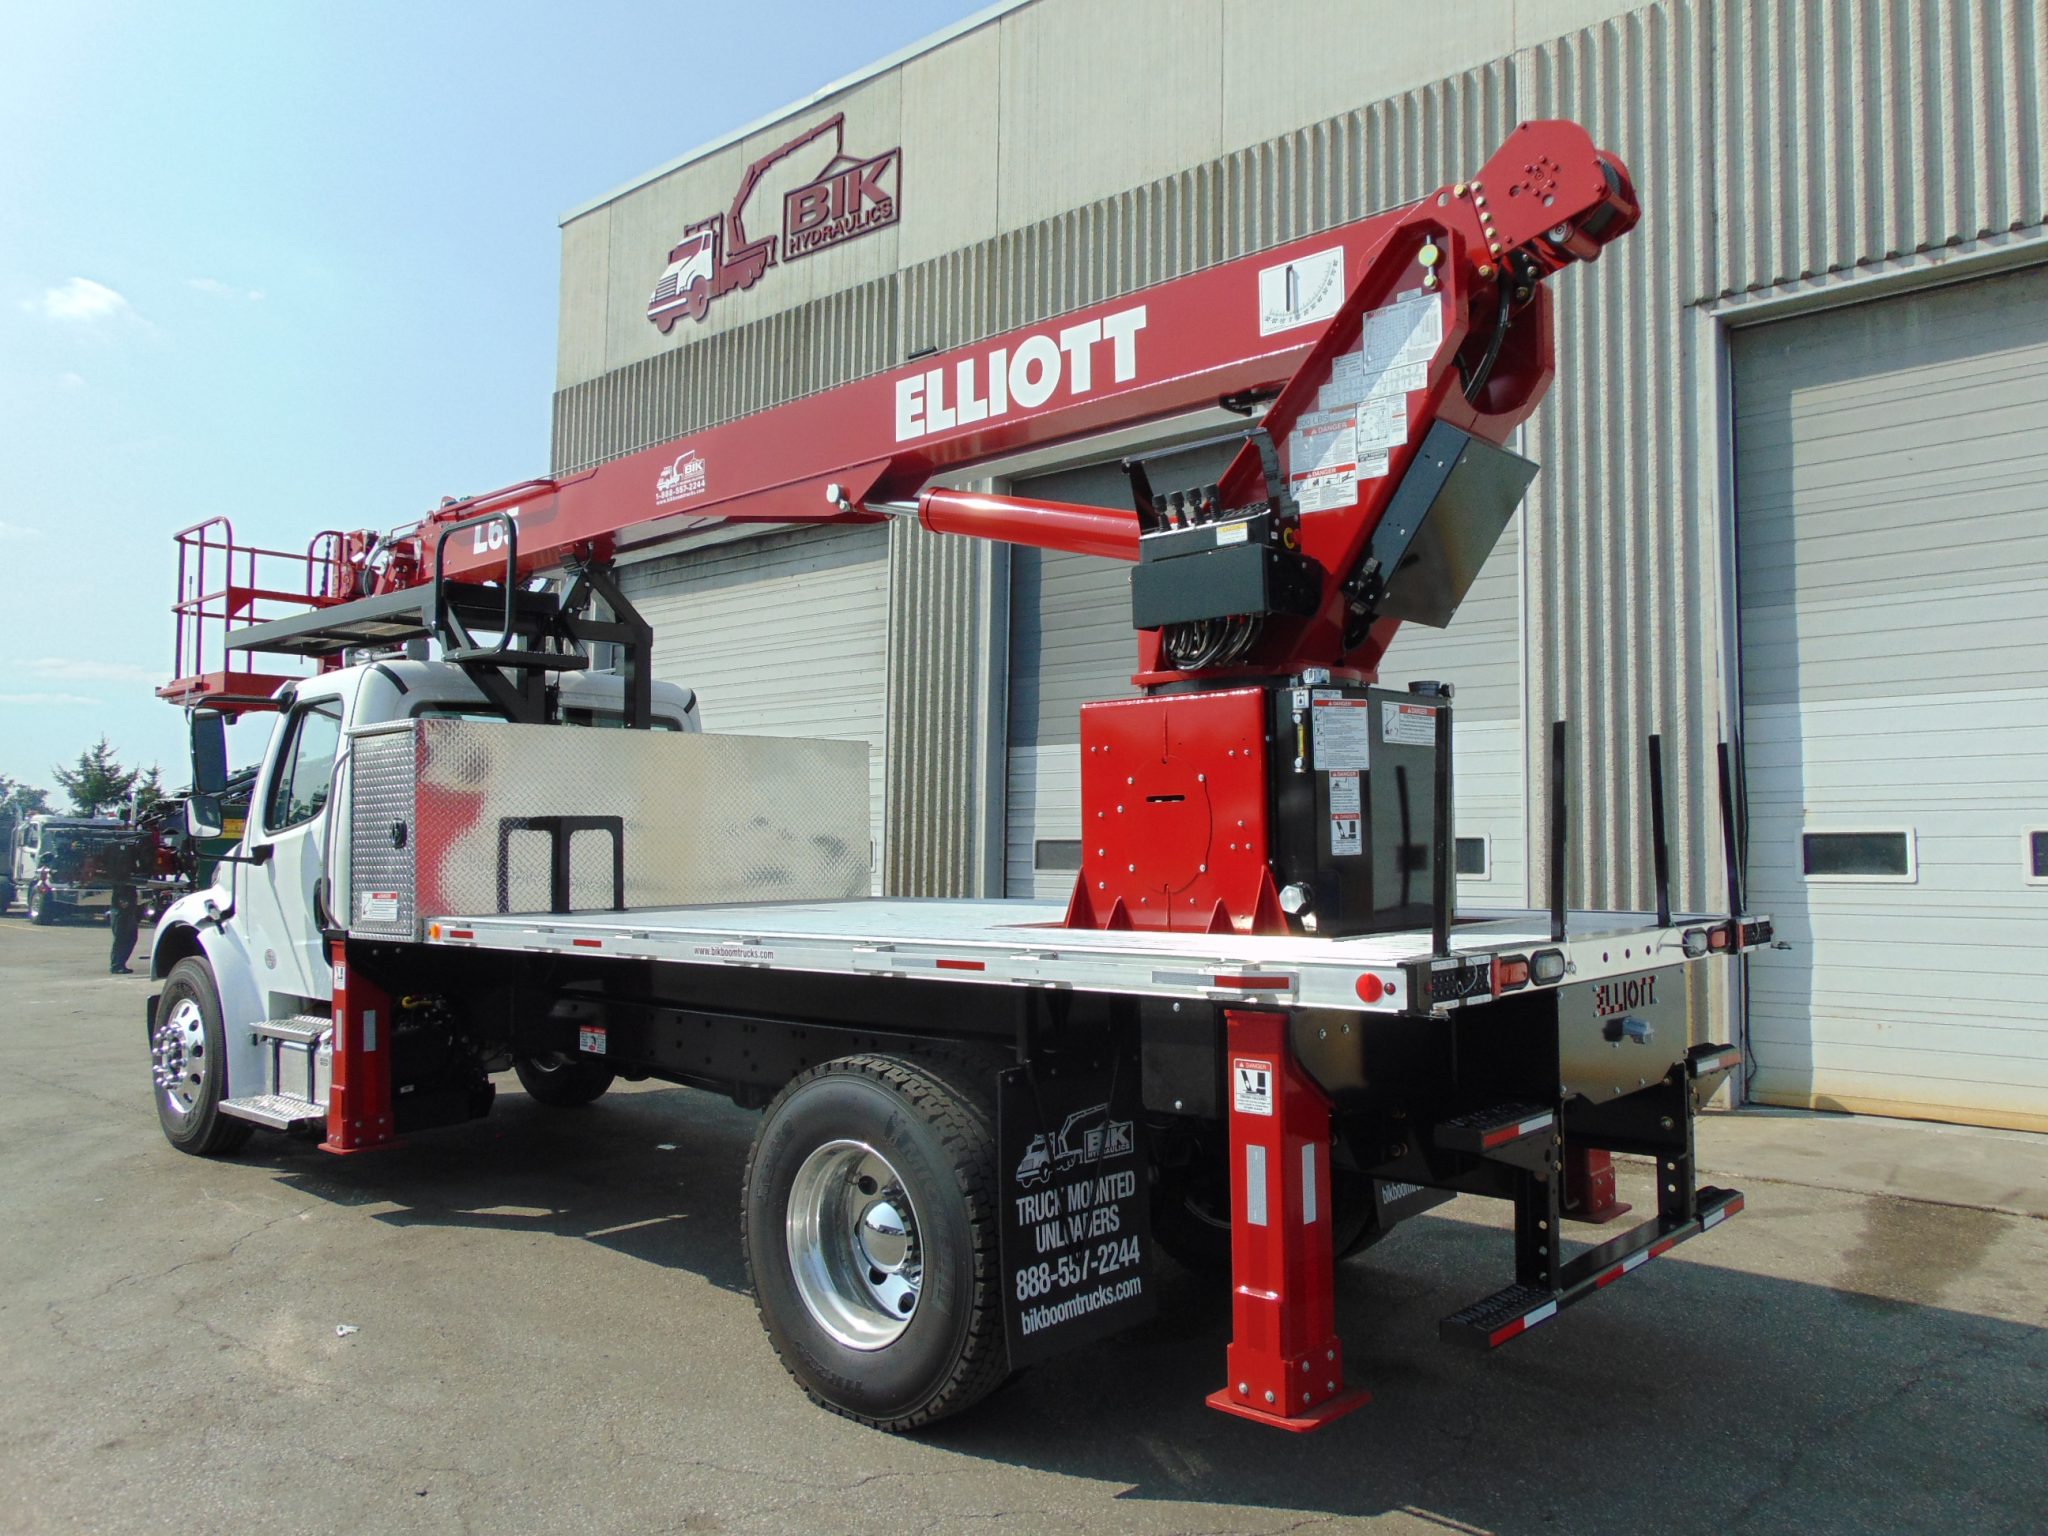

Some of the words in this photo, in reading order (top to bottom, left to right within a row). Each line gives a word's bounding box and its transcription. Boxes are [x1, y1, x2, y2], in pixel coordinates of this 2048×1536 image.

[790, 158, 892, 233] BIK
[789, 201, 894, 256] HYDRAULICS
[895, 304, 1148, 443] ELLIOTT
[1312, 414, 1329, 425] LBS
[1318, 422, 1347, 434] DANGER
[684, 461, 703, 475] BIK
[1312, 467, 1337, 477] DANGER
[694, 945, 774, 960] www.bikboomtrucks.com
[1596, 975, 1657, 1017] ELLIOTT
[1087, 1126, 1131, 1153] BIK
[1016, 1234, 1141, 1302] 888-557-2244
[1021, 1276, 1142, 1336] bikboomtrucks.com
